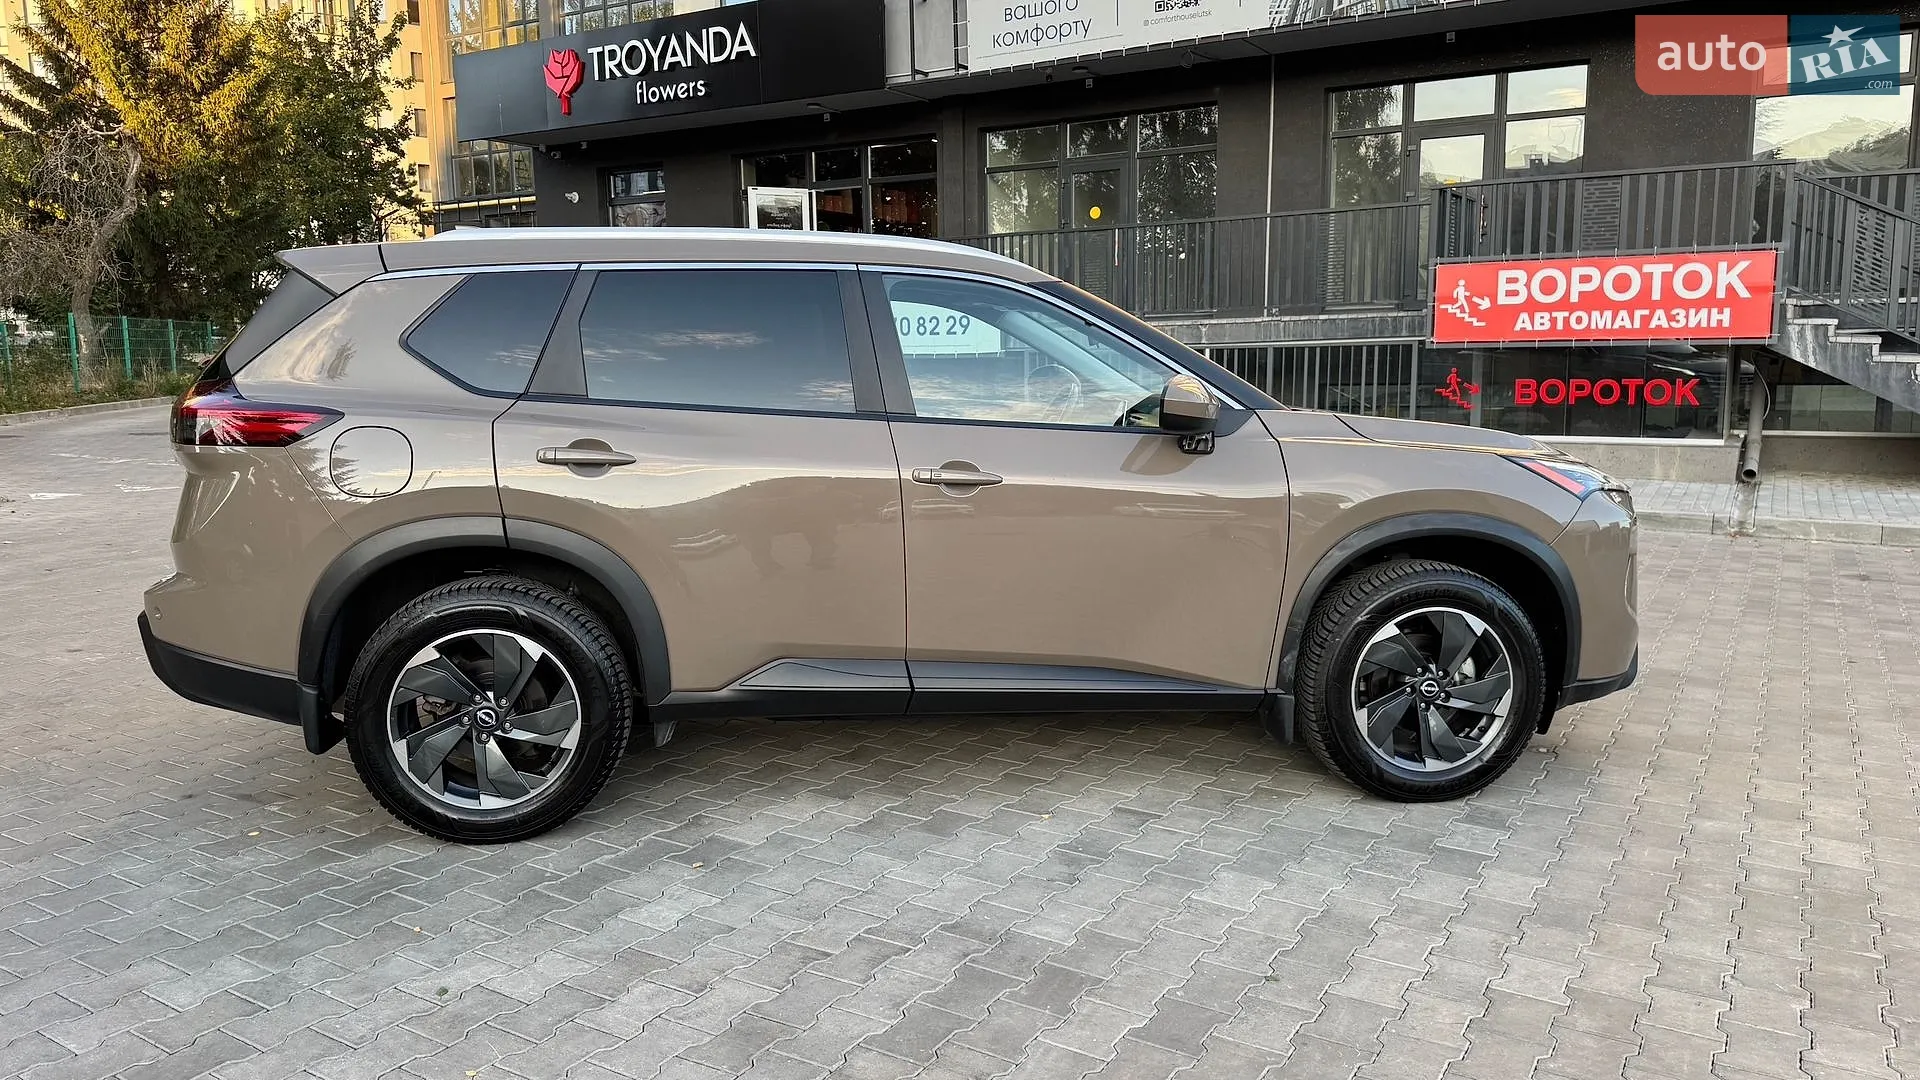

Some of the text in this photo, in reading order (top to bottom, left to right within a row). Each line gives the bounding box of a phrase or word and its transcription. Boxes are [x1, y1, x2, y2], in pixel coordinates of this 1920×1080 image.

[1004, 0, 1079, 22] вашого
[992, 18, 1092, 48] комфорту
[587, 20, 757, 81] TROYANDA
[636, 80, 706, 105] flowers
[1497, 260, 1752, 305] ВОРОТОК
[893, 315, 970, 336] 0 82 29
[1513, 307, 1731, 332] АВТОМАГАЗИН
[1514, 378, 1700, 407] ВОРОТОК
